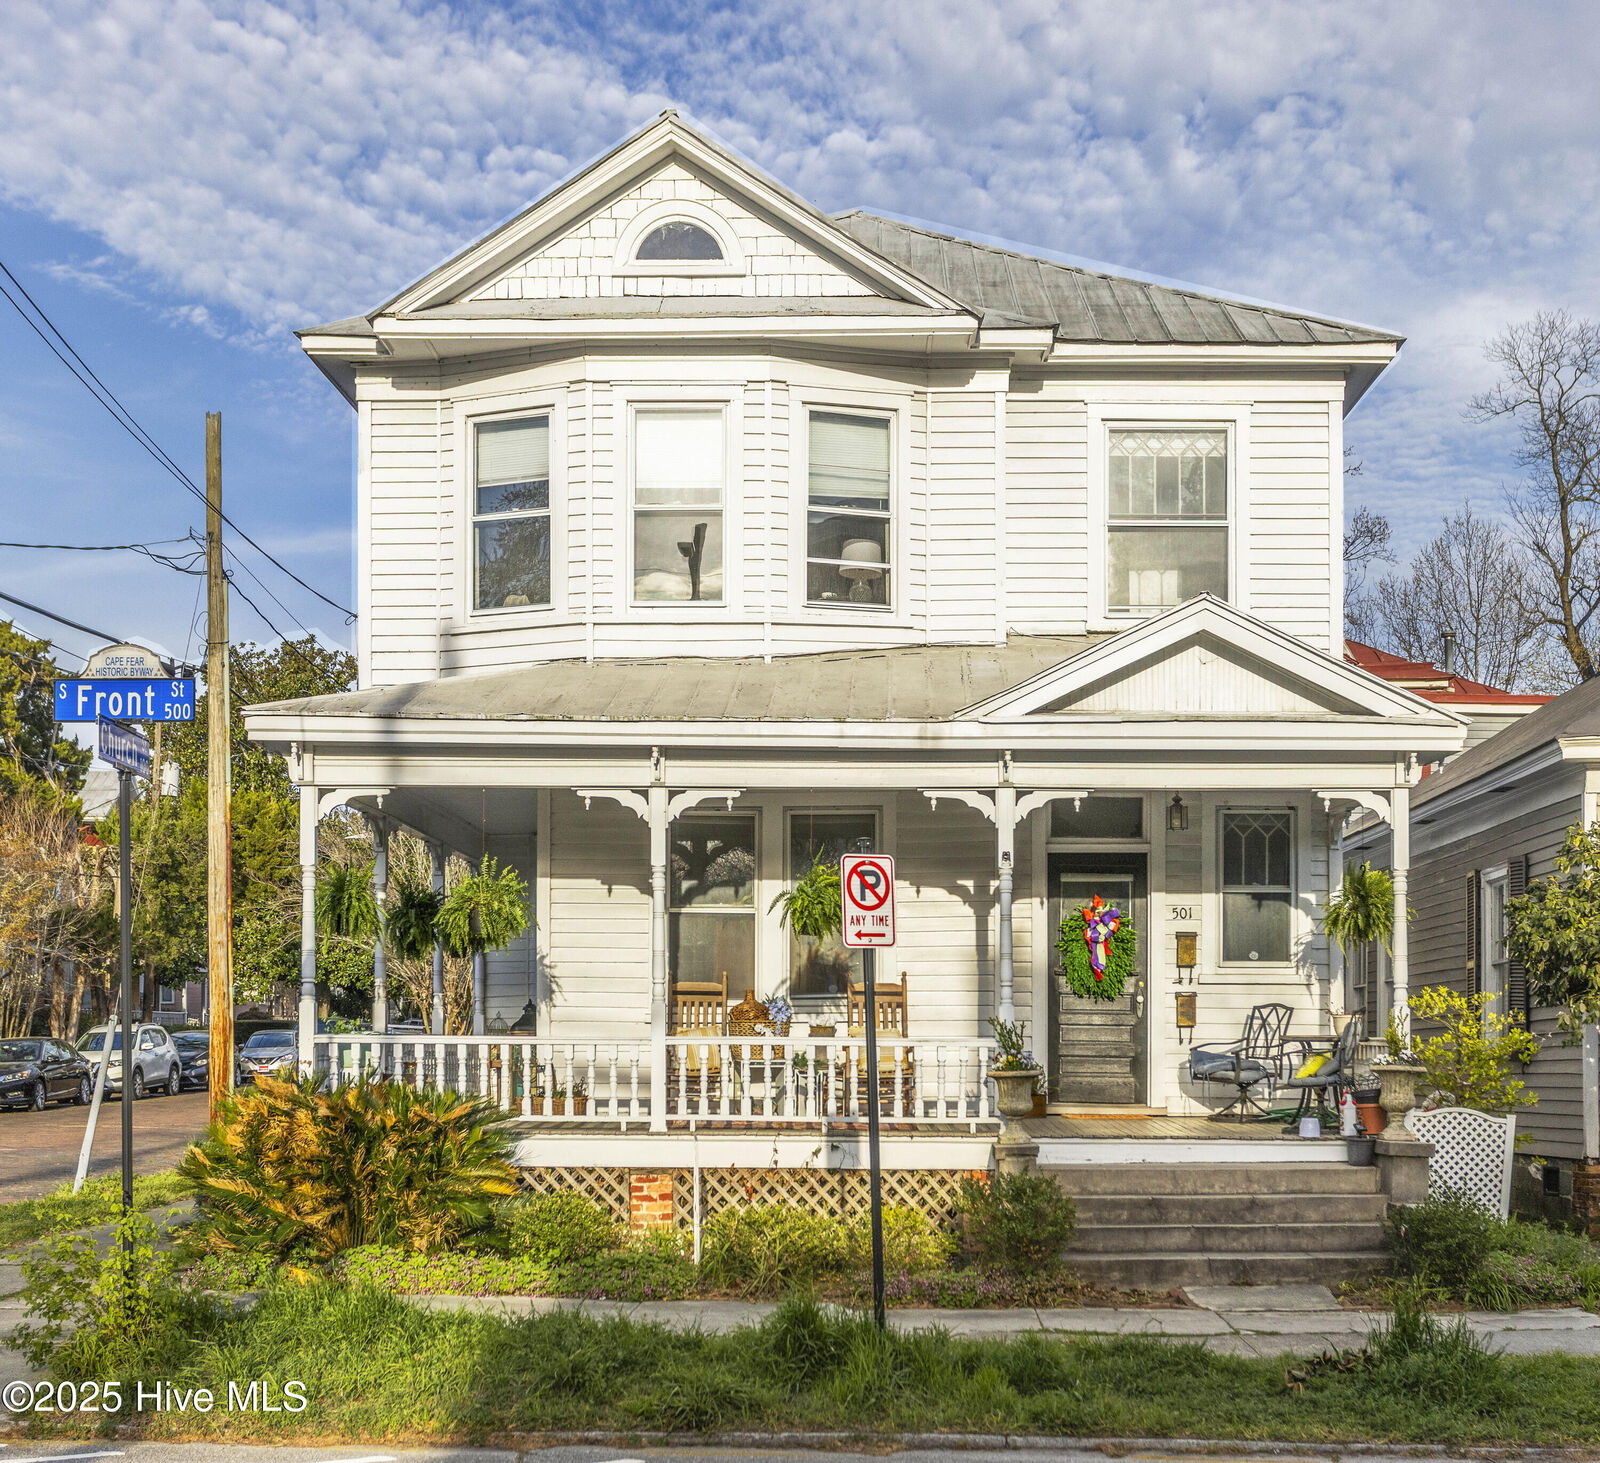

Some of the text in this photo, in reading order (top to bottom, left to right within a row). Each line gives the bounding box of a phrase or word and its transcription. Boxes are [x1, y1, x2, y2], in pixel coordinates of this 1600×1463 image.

[105, 656, 145, 666] CAPE FEAR
[95, 667, 154, 677] HISTORIC BYWAY
[59, 681, 185, 716] S Front St
[164, 703, 191, 719] 500
[101, 722, 138, 767] Church
[1172, 906, 1193, 920] 501
[850, 915, 889, 927] ANY TIME
